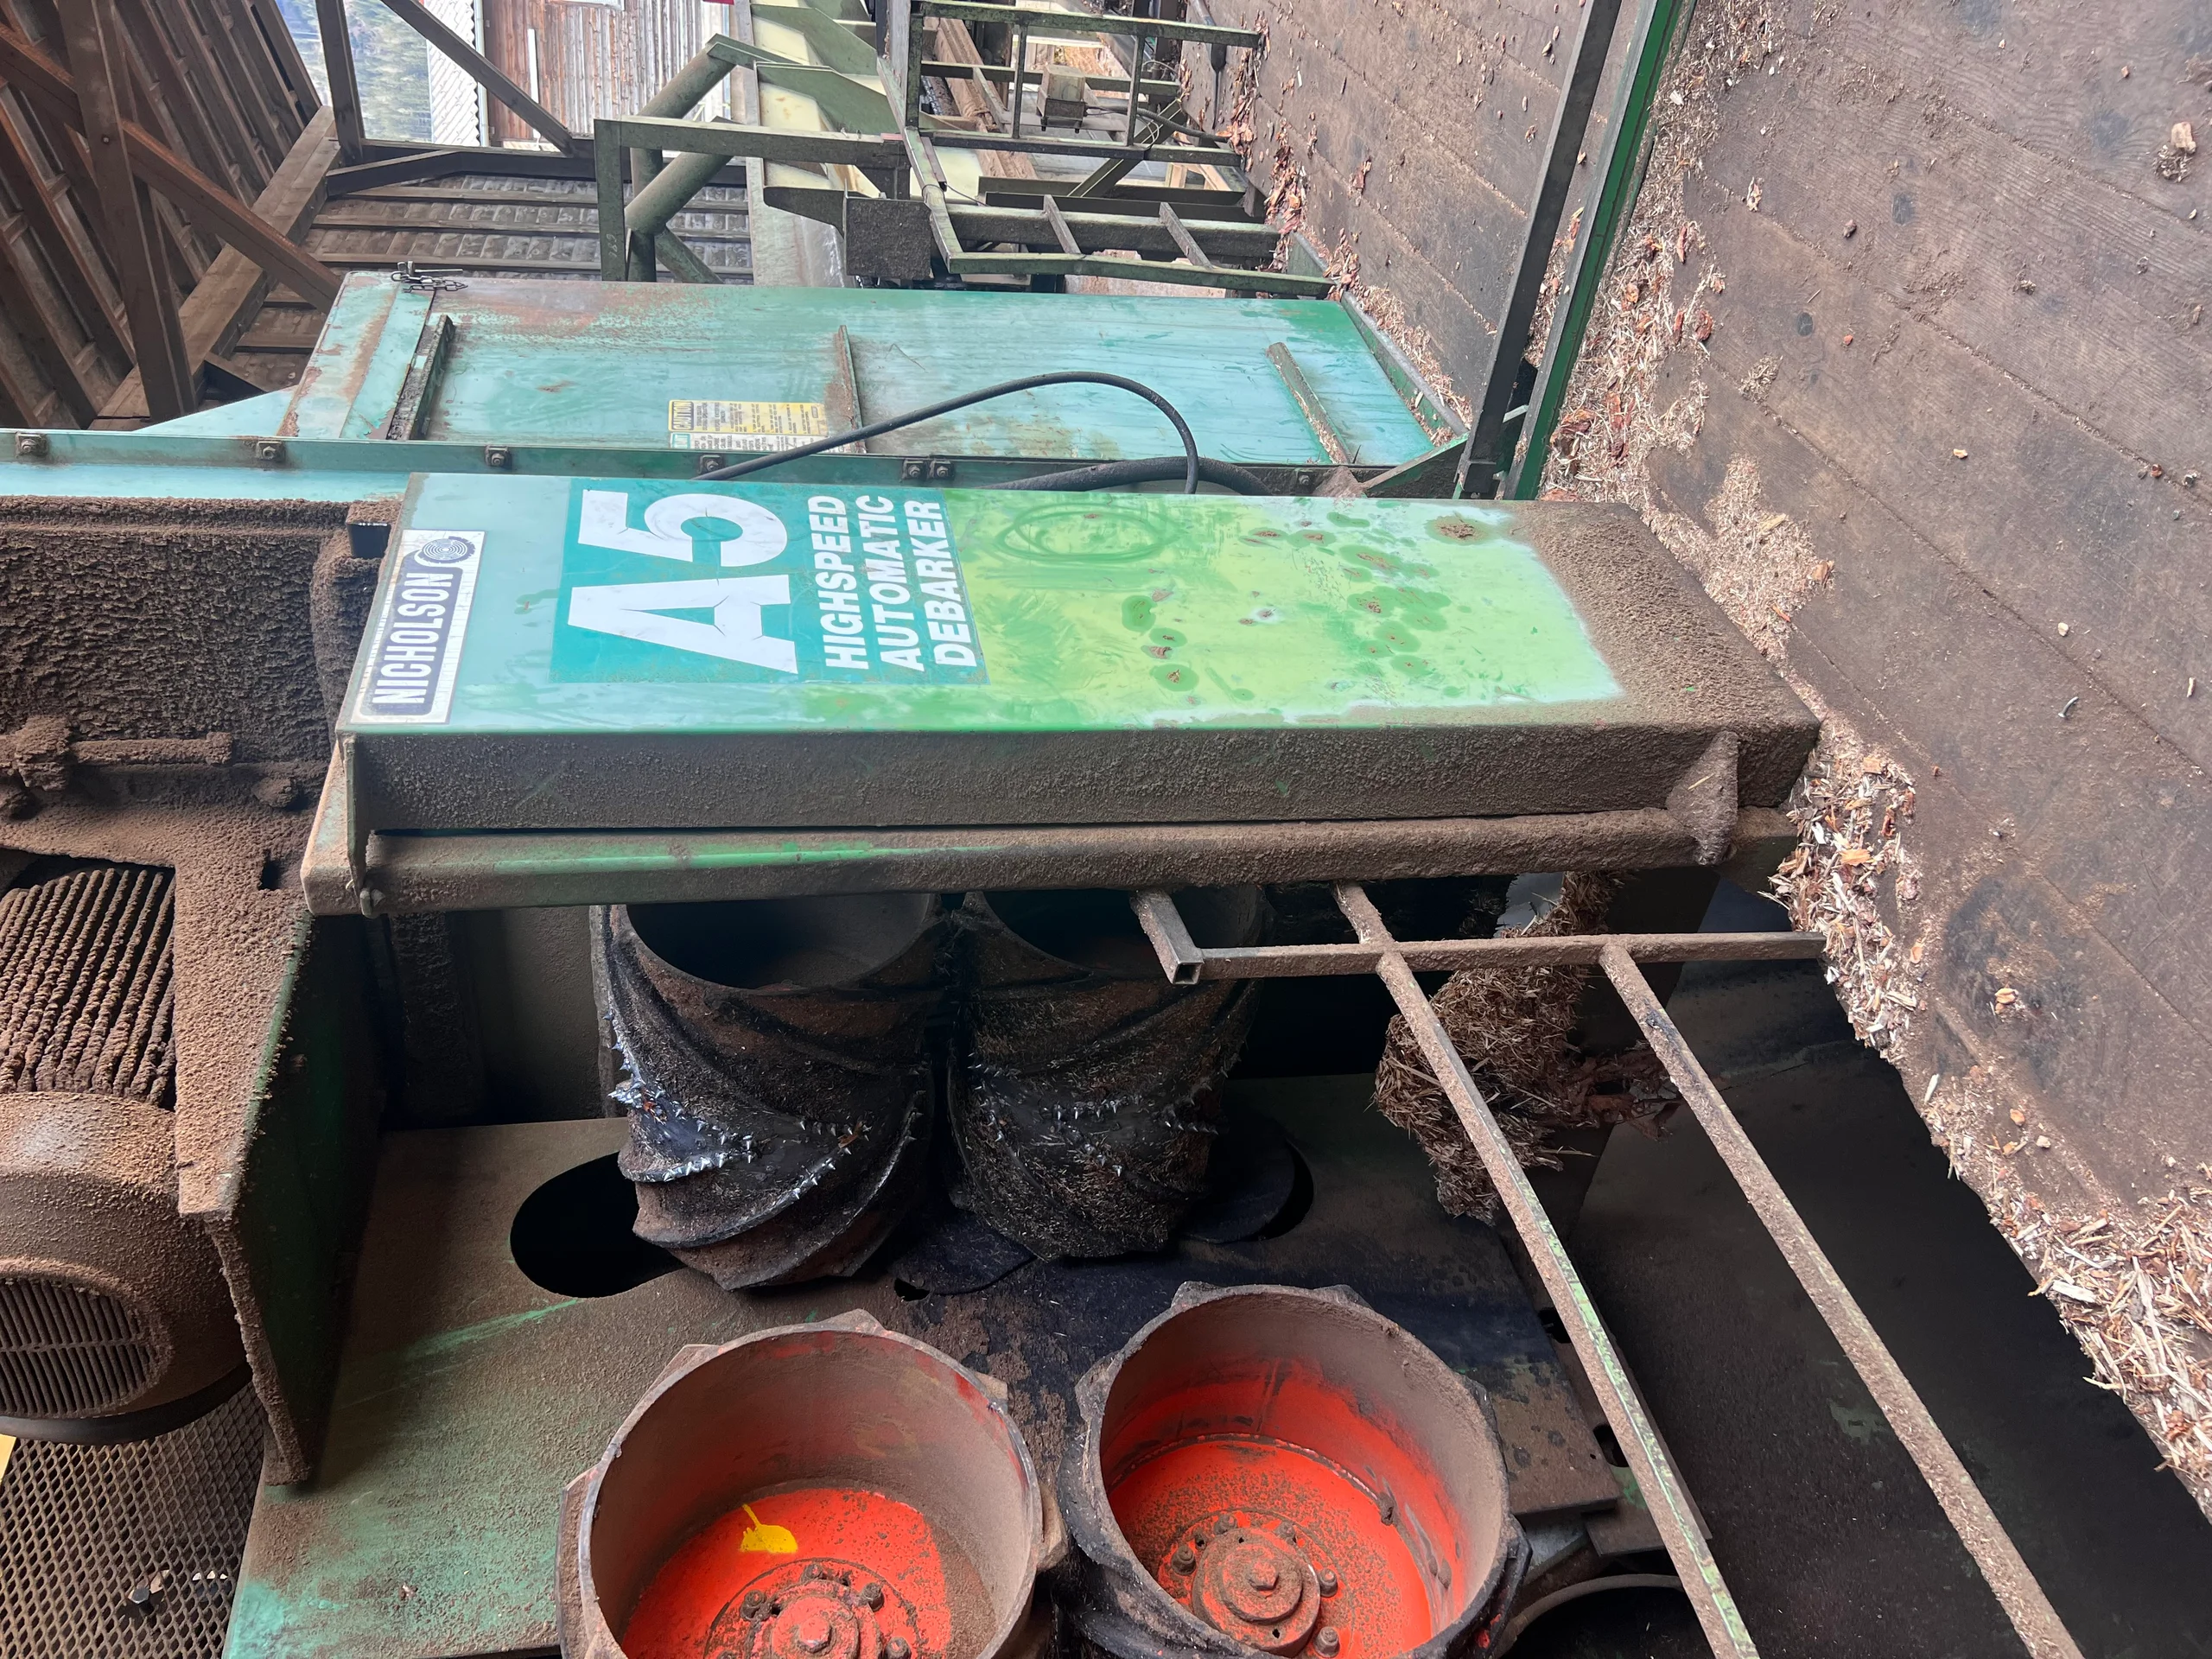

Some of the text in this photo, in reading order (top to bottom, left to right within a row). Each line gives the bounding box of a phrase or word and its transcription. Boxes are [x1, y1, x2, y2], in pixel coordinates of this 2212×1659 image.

[372, 571, 454, 705] NICHOLSON
[568, 489, 799, 674] A5
[808, 495, 870, 671] HIGHSPEED
[863, 494, 925, 673] AUTOMATIC
[903, 501, 976, 668] DEBARKER
